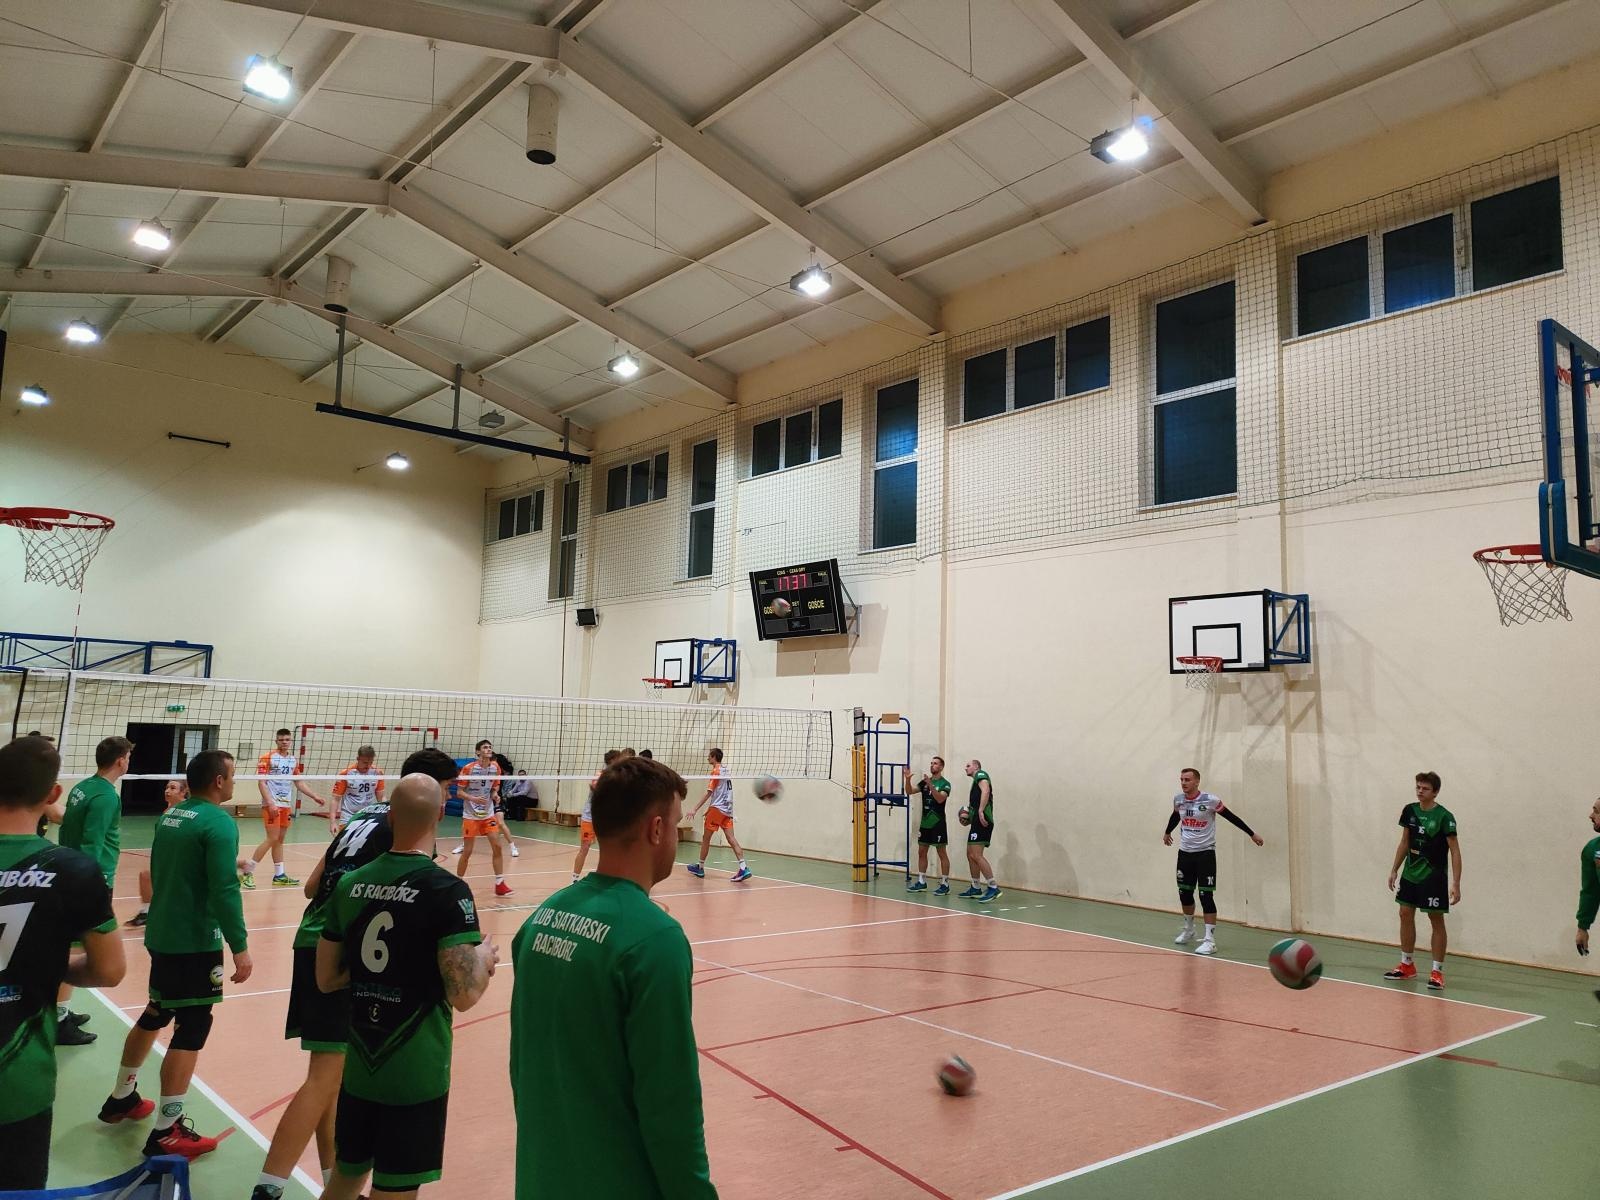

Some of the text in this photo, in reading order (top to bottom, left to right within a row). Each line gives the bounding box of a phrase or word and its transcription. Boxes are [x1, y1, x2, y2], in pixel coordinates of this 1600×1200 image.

[281, 765, 290, 775] 23
[358, 783, 370, 793] 26
[333, 819, 379, 859] 14
[351, 880, 420, 903] KS RACIBÓRZ
[1428, 897, 1440, 907] 16
[551, 910, 611, 944] SIATKARSKI
[361, 911, 395, 973] 6
[532, 932, 578, 962] RACIBÓRZ
